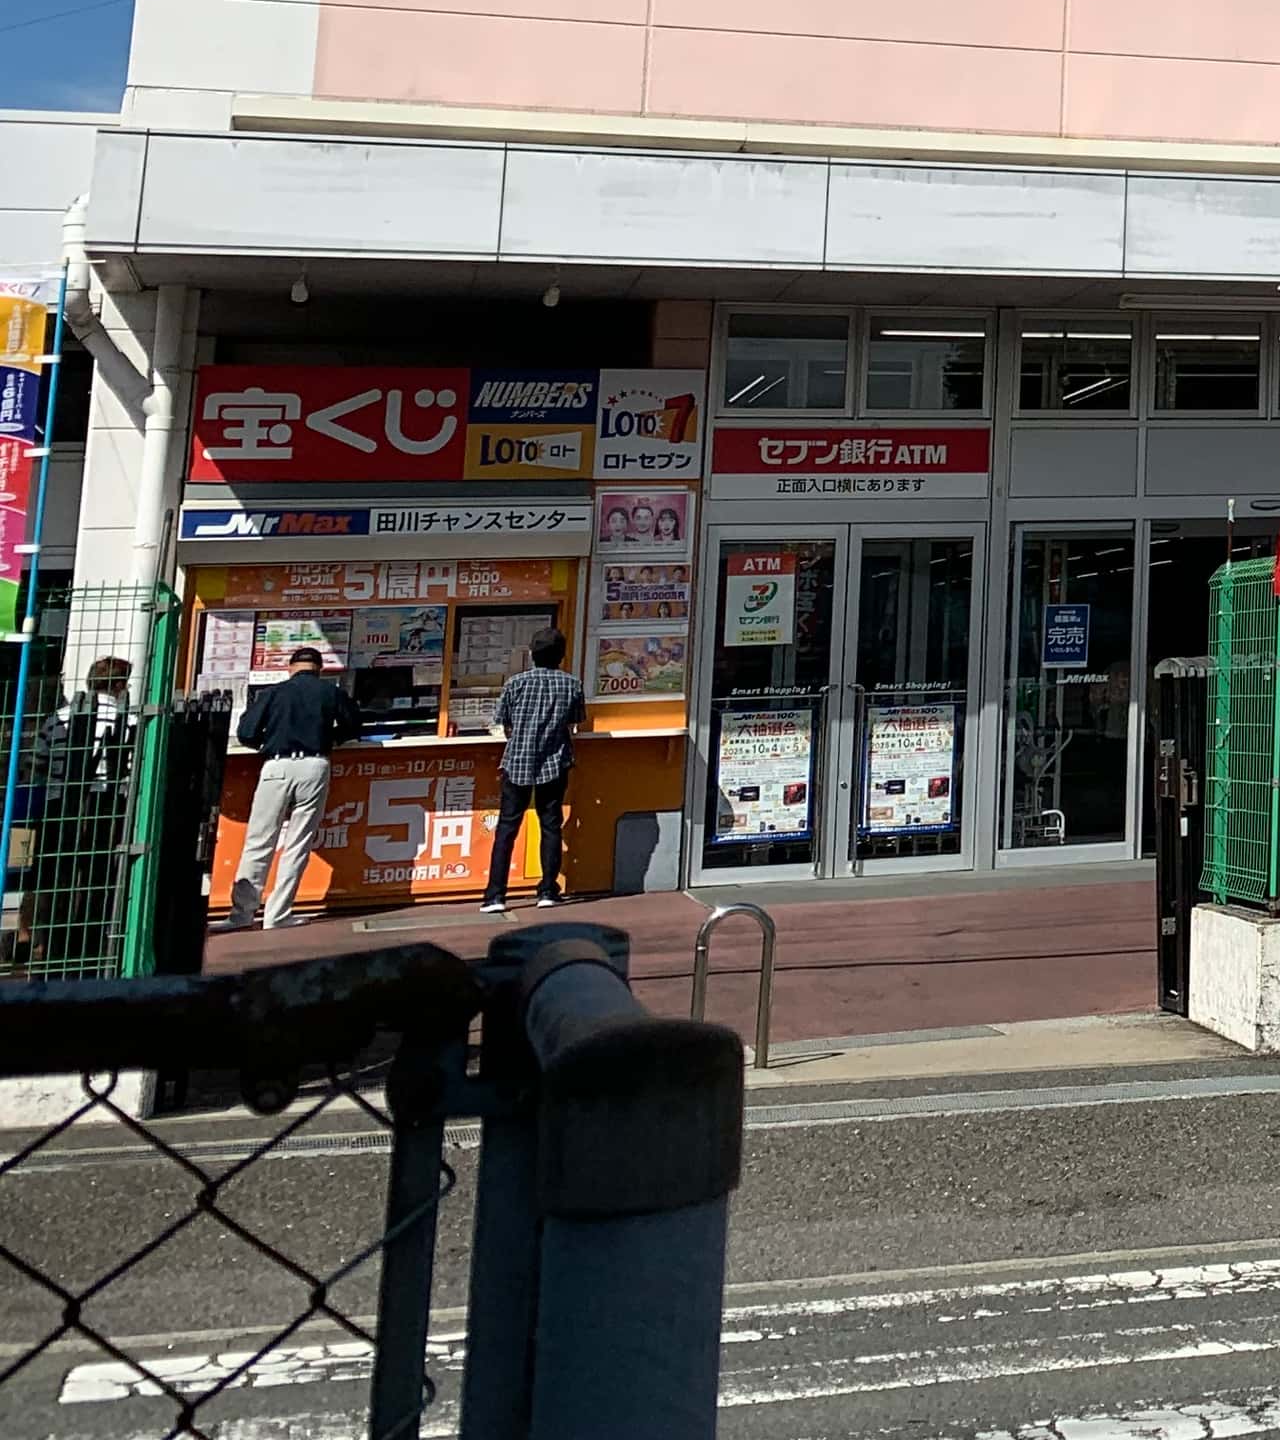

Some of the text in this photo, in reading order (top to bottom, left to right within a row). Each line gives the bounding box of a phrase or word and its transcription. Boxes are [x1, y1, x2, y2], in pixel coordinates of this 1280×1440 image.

[473, 381, 593, 408] NUMBERS
[203, 387, 458, 460] 宝くじ
[509, 410, 548, 419] ナンバーズ
[600, 408, 656, 439] LOTO
[480, 435, 577, 466] LOTO ロト
[603, 452, 692, 470] ロトセブン
[777, 478, 926, 493] 正面入口横にあります
[195, 511, 587, 536] MrMax 田川チャンスセンター
[743, 558, 781, 571] ATM
[344, 562, 458, 601] 5億円
[1047, 626, 1085, 645] 完売
[1056, 673, 1110, 684] MrMax
[364, 775, 476, 863] 5億円
